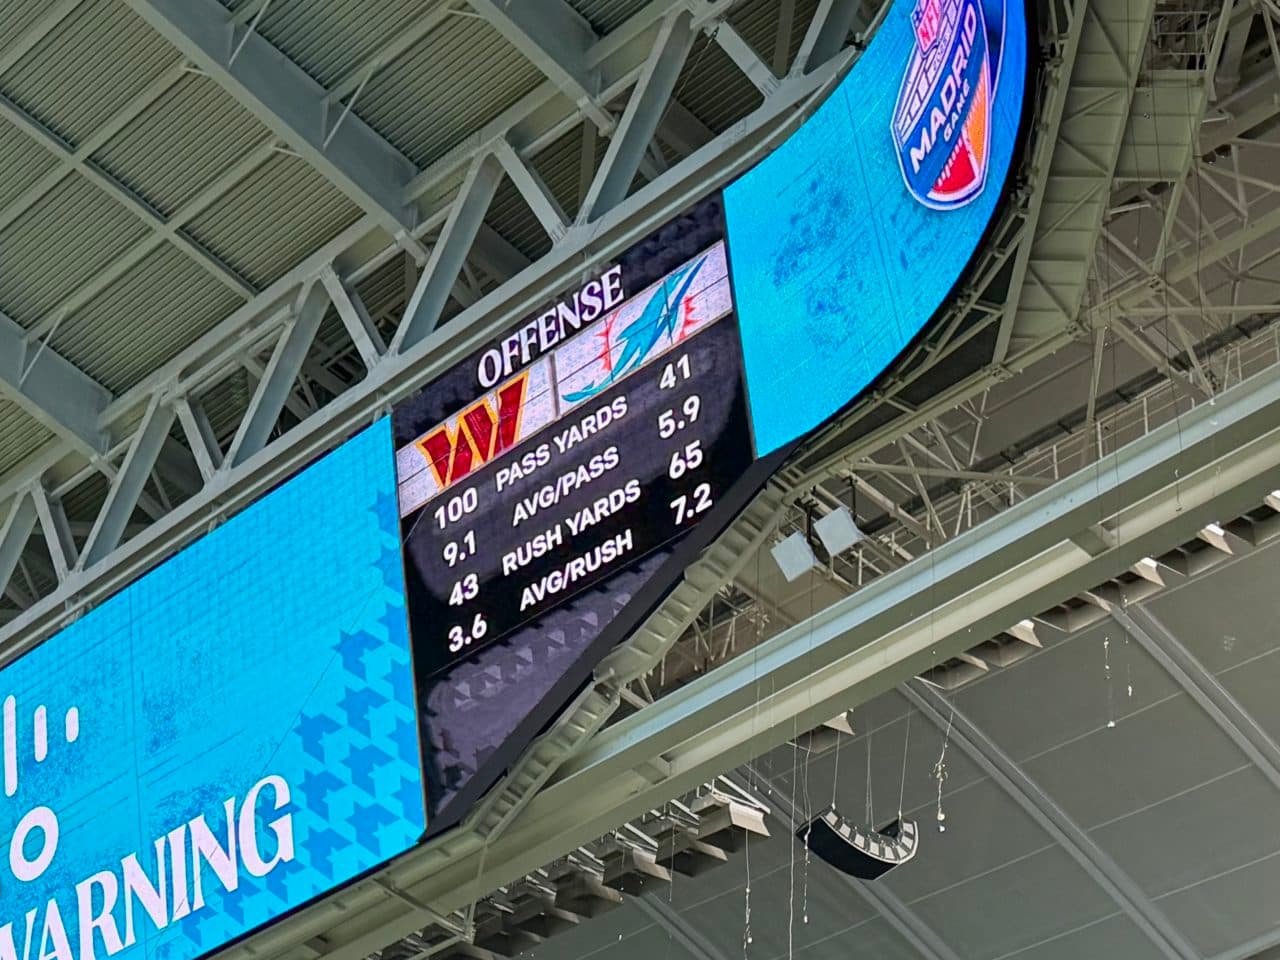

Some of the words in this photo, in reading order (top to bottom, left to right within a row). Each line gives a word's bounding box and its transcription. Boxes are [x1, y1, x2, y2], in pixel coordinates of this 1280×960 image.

[910, 3, 976, 174] MADRID
[944, 78, 970, 142] GAME
[477, 265, 624, 389] OFFENSE
[434, 486, 479, 530] 100
[512, 445, 620, 527] AVG/PASS
[656, 395, 701, 440] 5.9
[495, 447, 551, 493] PASS
[553, 395, 628, 450] YARDS
[659, 353, 692, 391] 41
[442, 529, 477, 569] 9.1
[501, 526, 563, 577] RUSH
[564, 478, 641, 536] YARDS
[668, 440, 703, 480] 65
[448, 573, 480, 607] 43
[519, 529, 634, 612] AVG/RUSH
[669, 482, 713, 526] 7.2
[448, 613, 488, 654] 3.6
